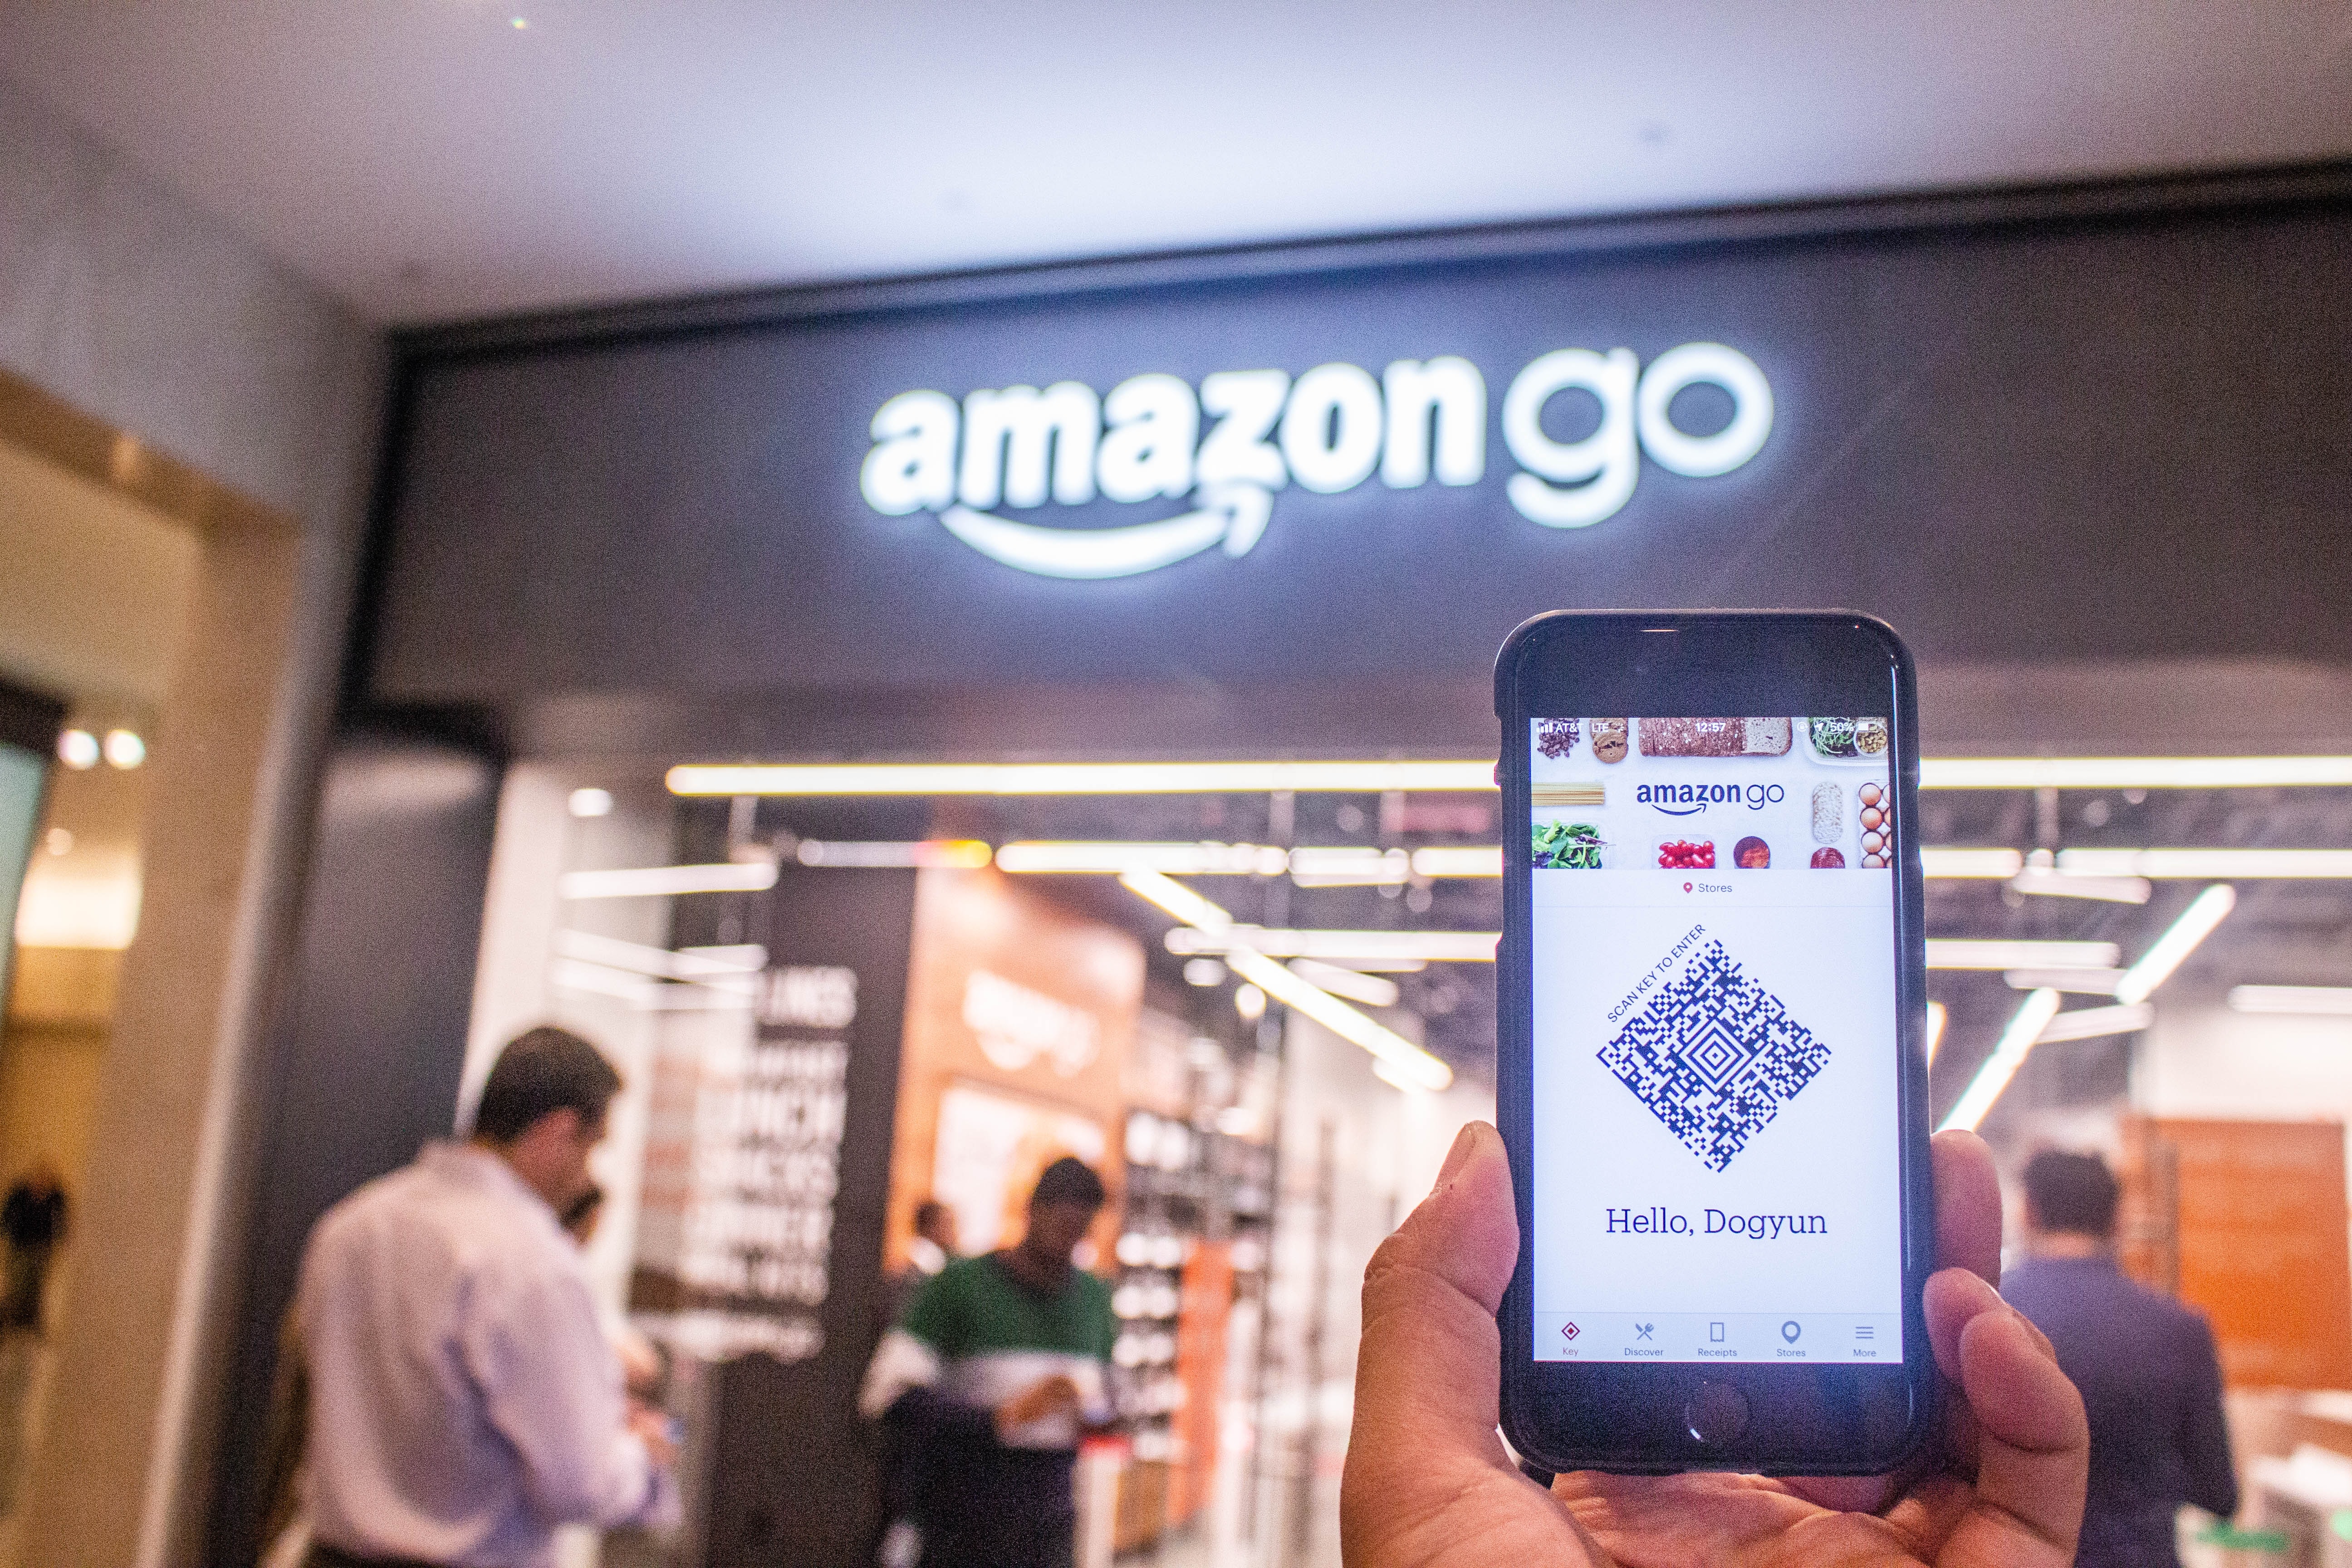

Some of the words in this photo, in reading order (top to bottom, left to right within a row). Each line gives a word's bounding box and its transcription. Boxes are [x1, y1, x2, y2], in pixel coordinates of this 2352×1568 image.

[860, 355, 1488, 516] amazon
[1501, 341, 1774, 530] go
[1555, 723, 1583, 733] AT&T
[1592, 723, 1608, 732] LTE
[1695, 722, 1726, 732] 12:57
[1831, 722, 1854, 731] 50%
[1636, 784, 1741, 804] amazon
[1746, 784, 1784, 810] go
[1698, 883, 1732, 893] Stores
[1608, 991, 1638, 1022] SCAN
[1636, 971, 1657, 994] KEY
[1655, 957, 1672, 972] TO
[1671, 924, 1706, 958] ENTER
[1606, 1207, 1694, 1236] Hello,
[1705, 1209, 1828, 1239] Dogyun
[1563, 1348, 1578, 1356] Key
[1624, 1348, 1664, 1356] Discover
[1698, 1348, 1737, 1357] Receipts
[1777, 1348, 1806, 1357] Stores
[1853, 1349, 1877, 1357] More
